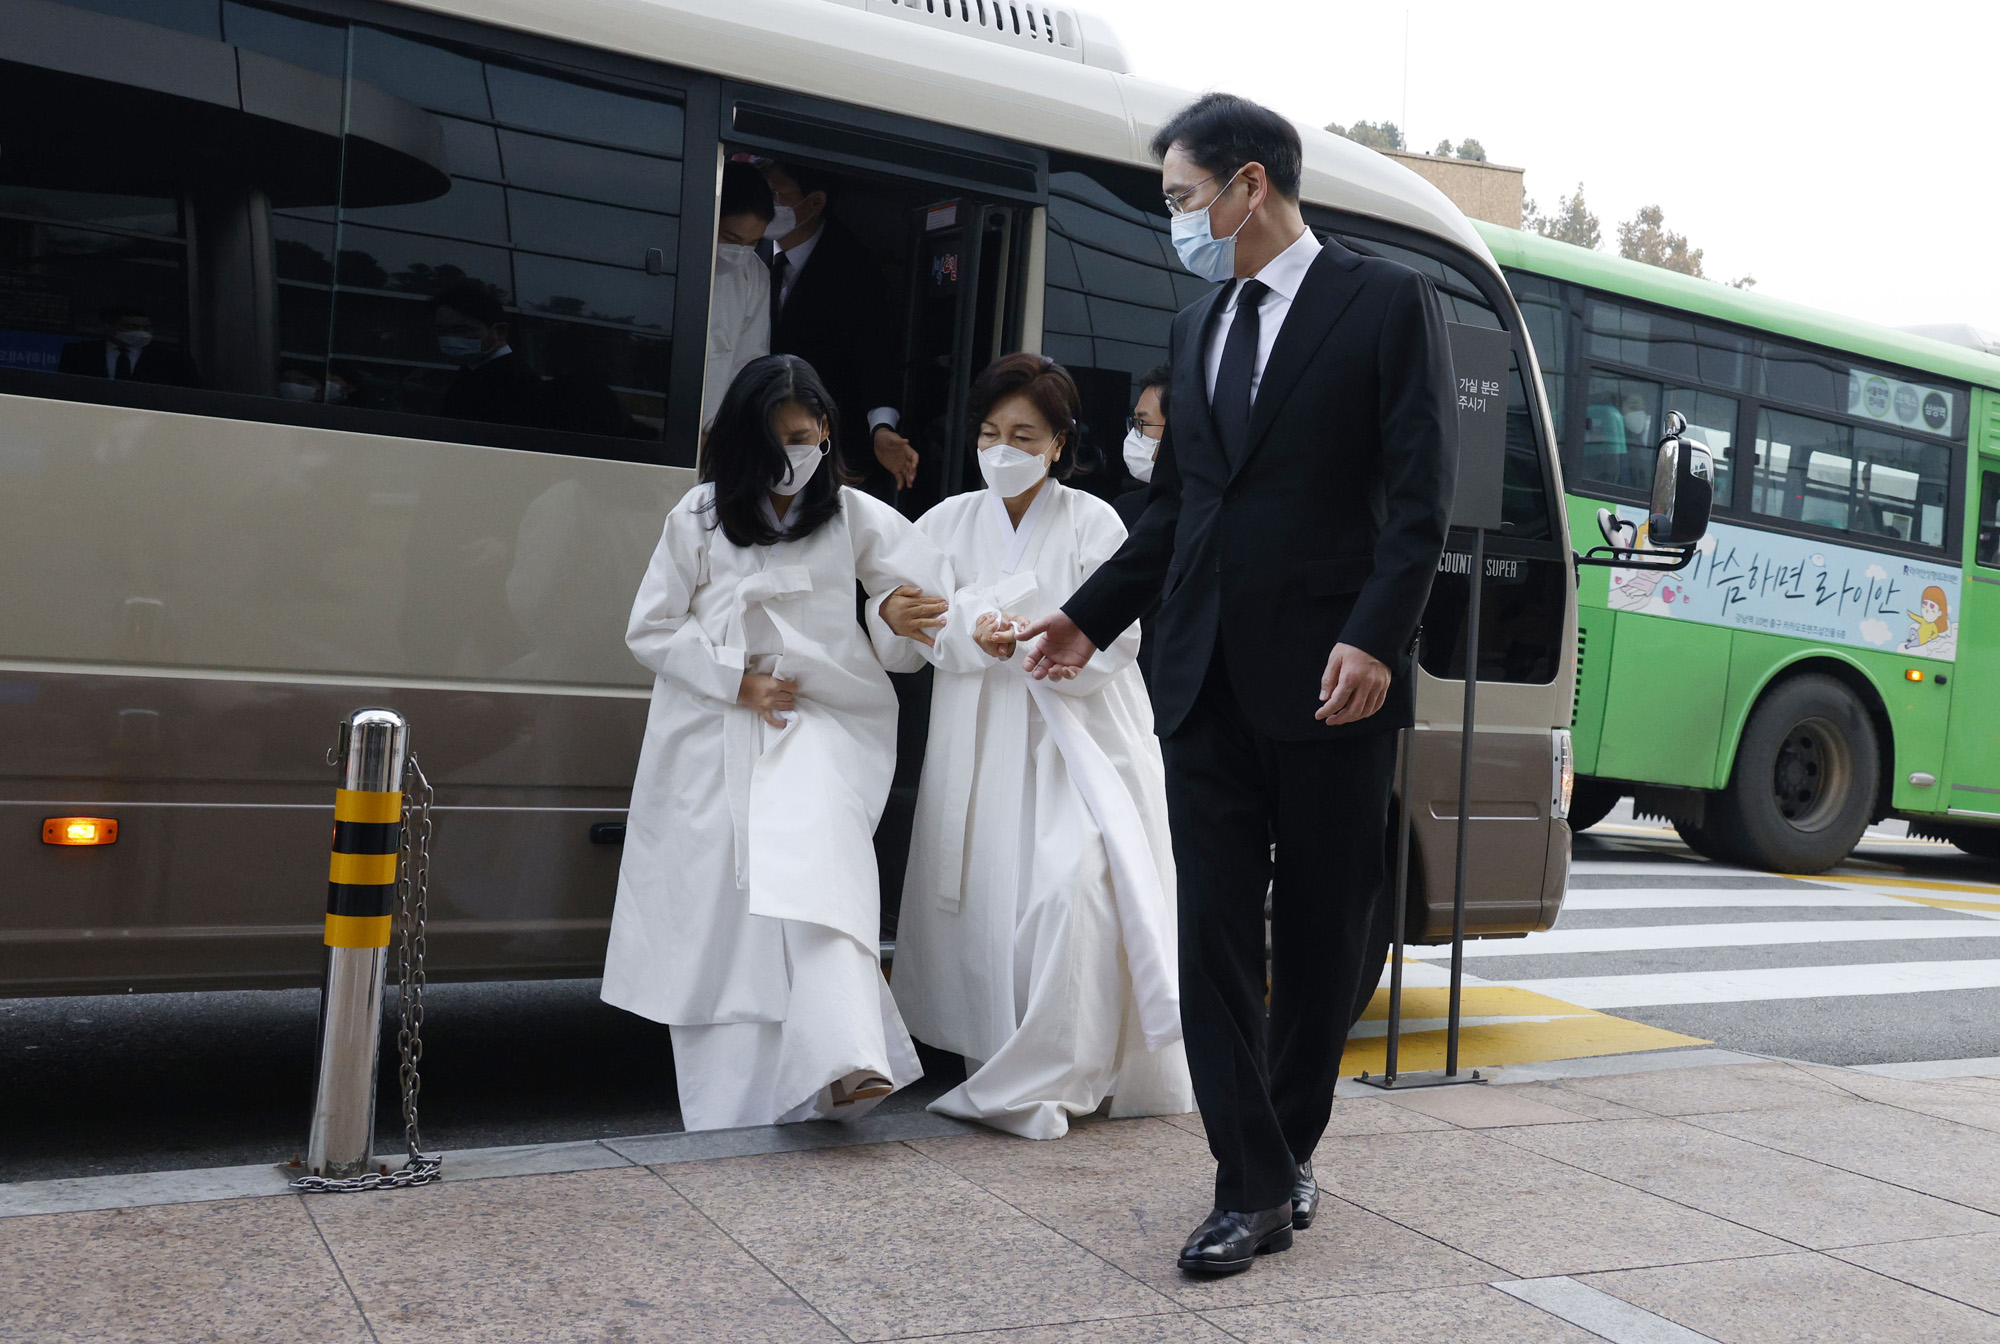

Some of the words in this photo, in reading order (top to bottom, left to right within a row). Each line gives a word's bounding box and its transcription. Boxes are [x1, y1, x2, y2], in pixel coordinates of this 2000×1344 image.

[1459, 377, 1478, 394] 가실
[1481, 380, 1500, 397] 분은
[1458, 395, 1486, 413] 주시기
[1924, 403, 1947, 419] 삼성역
[1437, 551, 1473, 575] COUNT
[1485, 558, 1517, 578] SUPER
[1692, 538, 1806, 617] 가슴하면
[1815, 568, 1900, 618] 라이안
